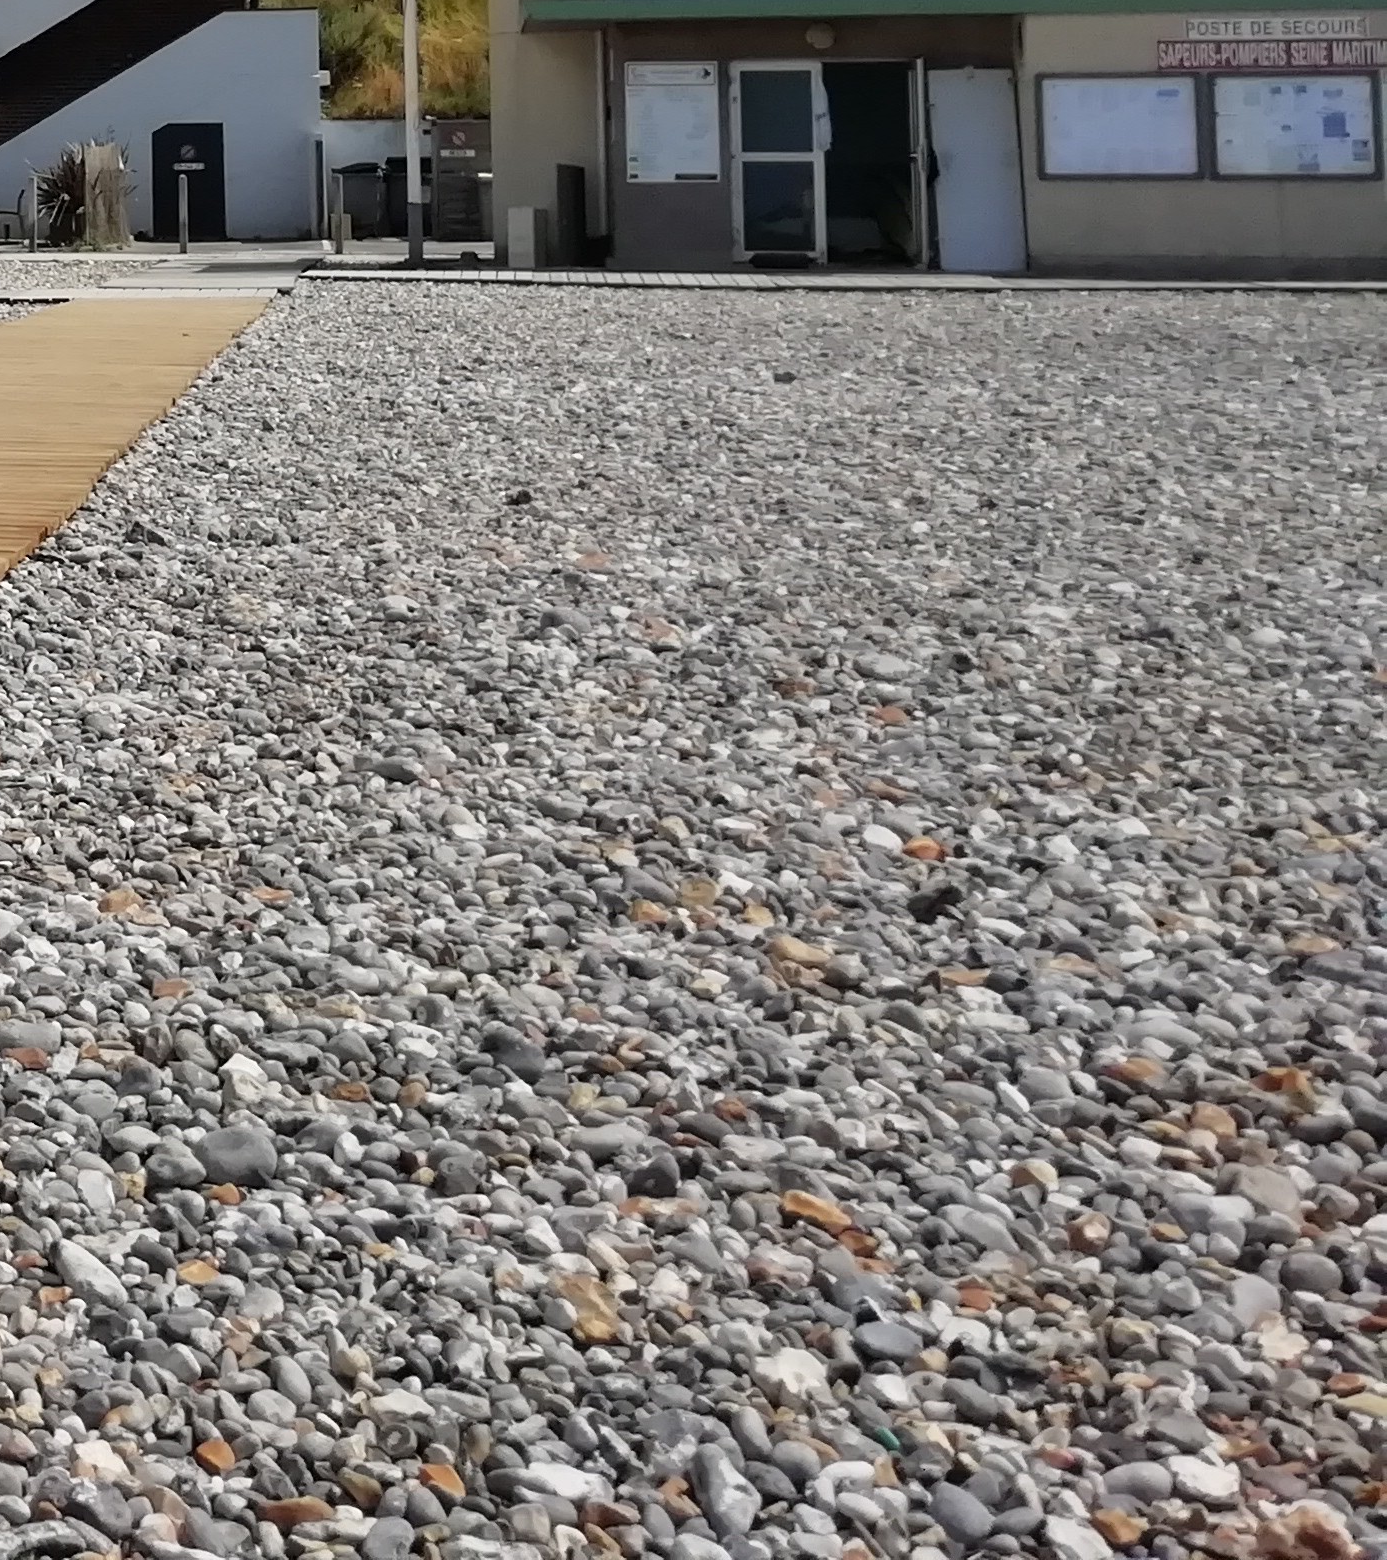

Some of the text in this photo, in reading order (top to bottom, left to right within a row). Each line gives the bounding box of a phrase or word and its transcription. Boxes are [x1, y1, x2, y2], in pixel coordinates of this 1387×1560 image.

[1186, 18, 1368, 37] POSTE DE SECOURS
[1158, 41, 1287, 67] SAPEURS-POMPIERS
[1290, 41, 1328, 66] SEINE
